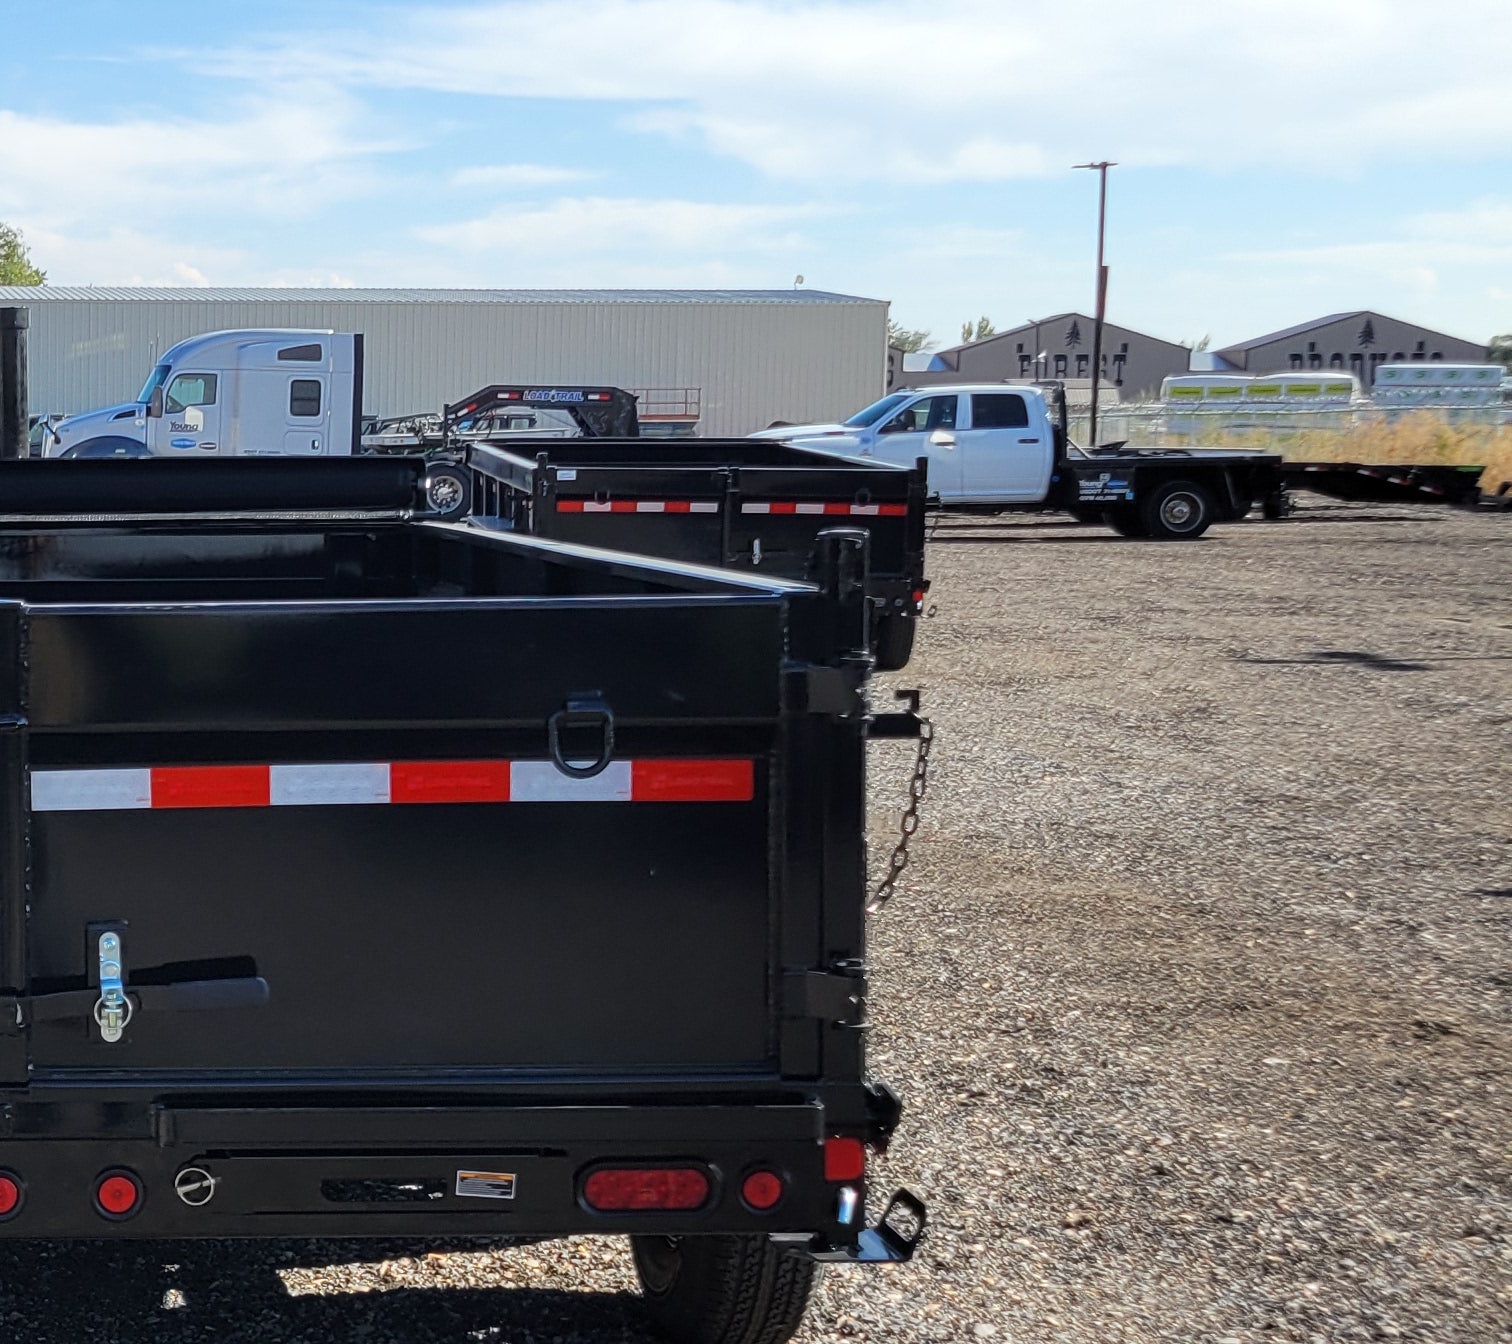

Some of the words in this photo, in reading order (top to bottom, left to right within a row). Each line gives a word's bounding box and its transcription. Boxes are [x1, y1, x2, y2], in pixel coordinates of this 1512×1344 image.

[523, 390, 551, 401] LOAD
[554, 391, 584, 401] TRAIL
[169, 421, 199, 433] Young
